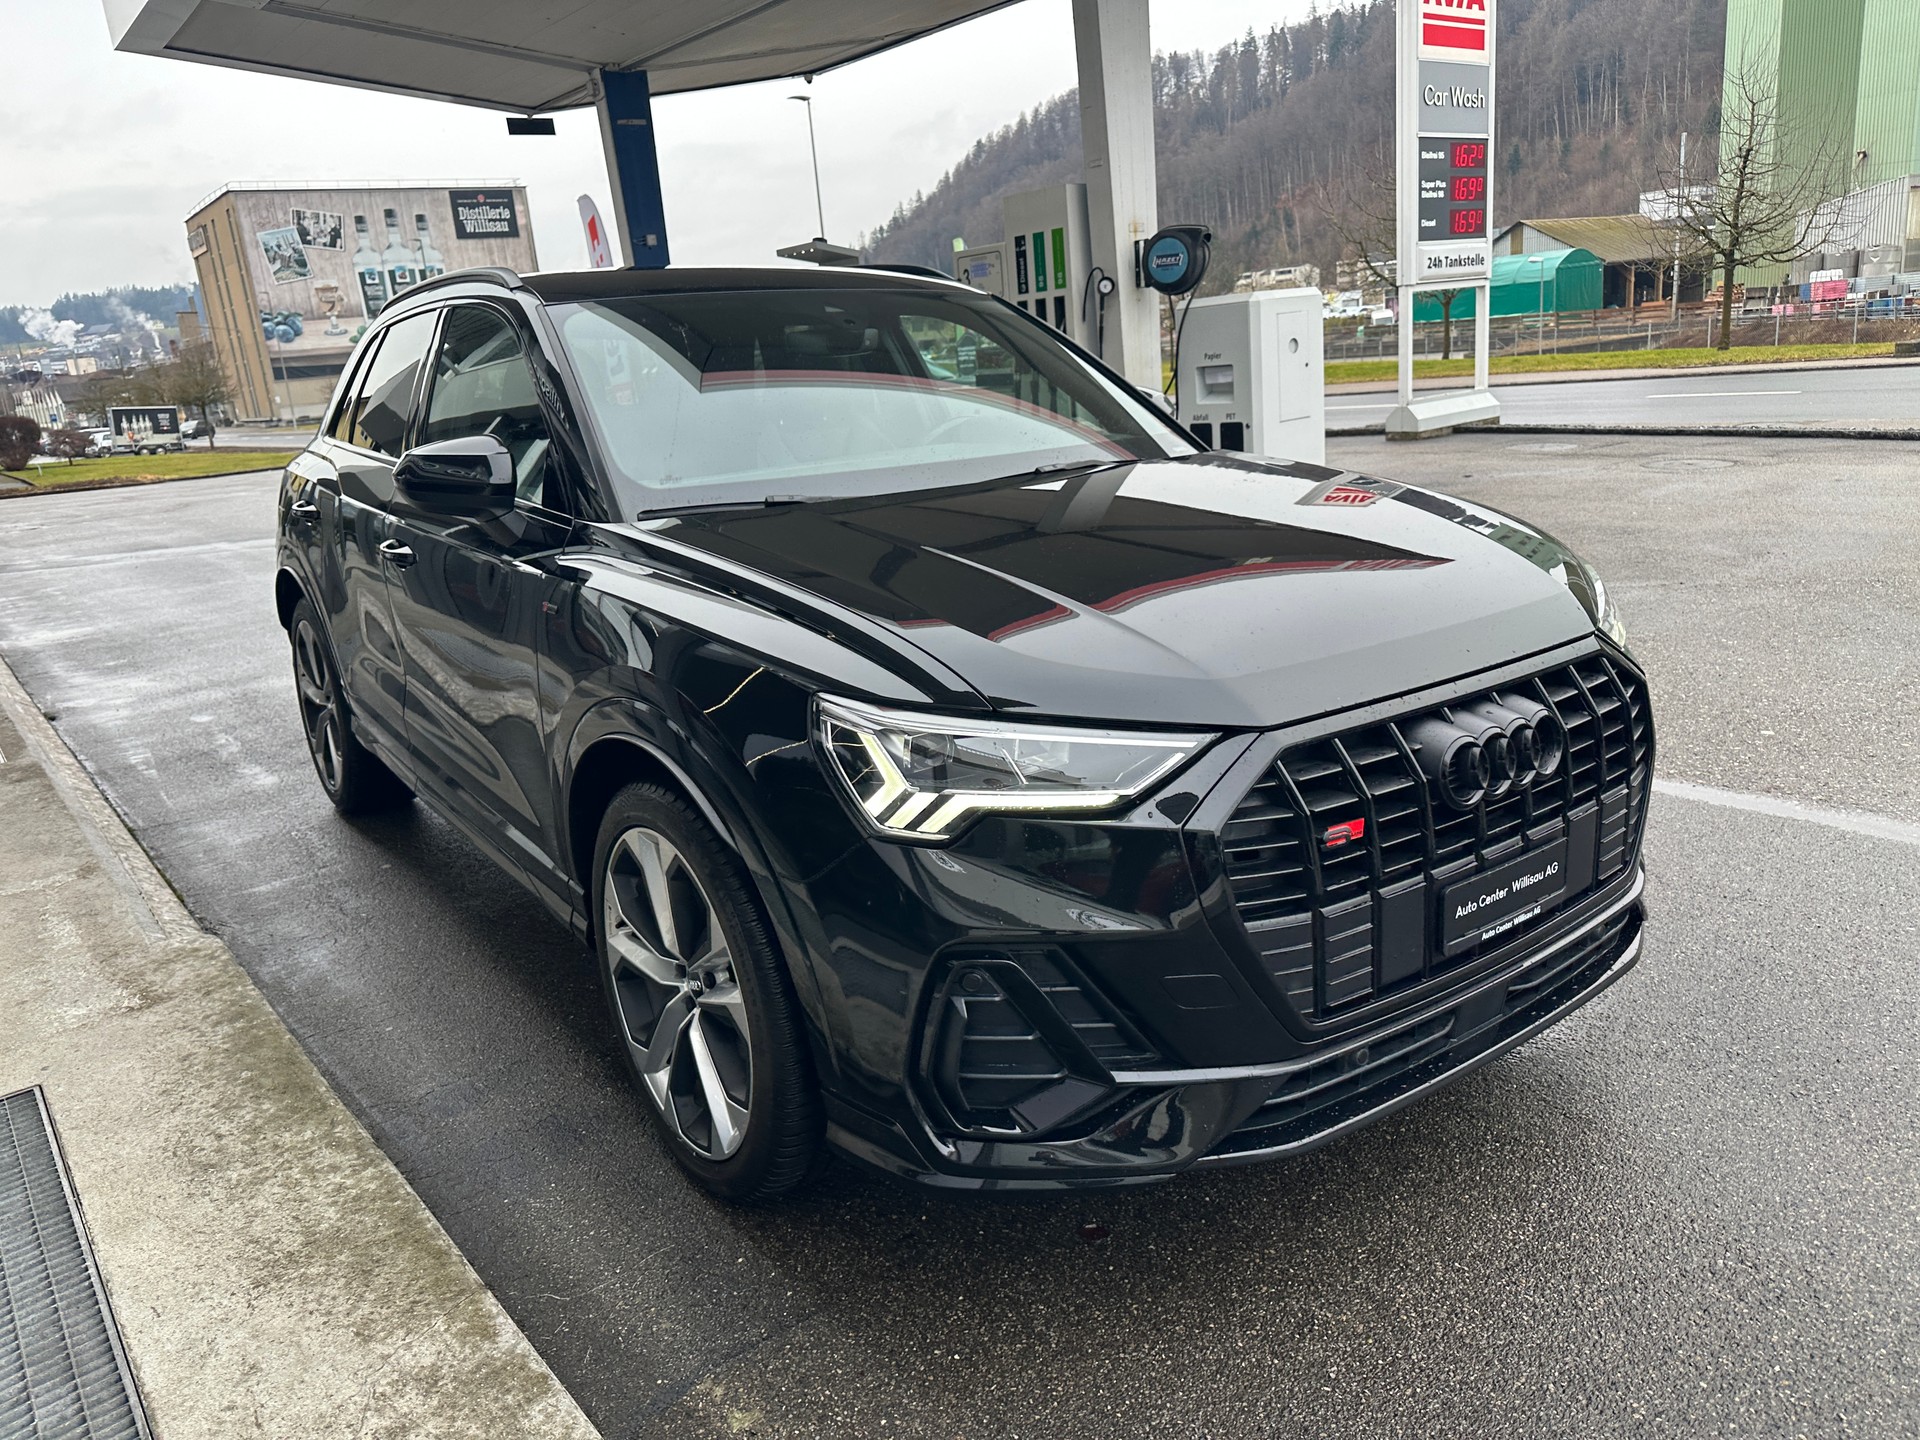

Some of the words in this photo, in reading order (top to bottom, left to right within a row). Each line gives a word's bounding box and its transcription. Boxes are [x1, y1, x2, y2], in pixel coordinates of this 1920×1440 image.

[1424, 84, 1448, 106] Car
[1450, 85, 1485, 108] Wash
[1421, 180, 1435, 189] Super
[1435, 180, 1447, 188] Plus
[457, 205, 511, 220] Distillerie
[463, 219, 510, 233] Willisau
[1421, 218, 1437, 227] Diesel
[1154, 255, 1181, 266] HAZET
[1427, 255, 1443, 269] 24h
[1444, 253, 1485, 268] Tankstelle
[1203, 352, 1222, 362] Papier
[1455, 901, 1477, 919] Auto
[1479, 887, 1508, 907] Center
[1512, 870, 1544, 893] Willisau
[1545, 861, 1559, 877] AG
[1481, 929, 1495, 940] Auto
[1496, 921, 1513, 934] Center
[1513, 909, 1533, 926] Willisau
[1533, 905, 1541, 916] AG
